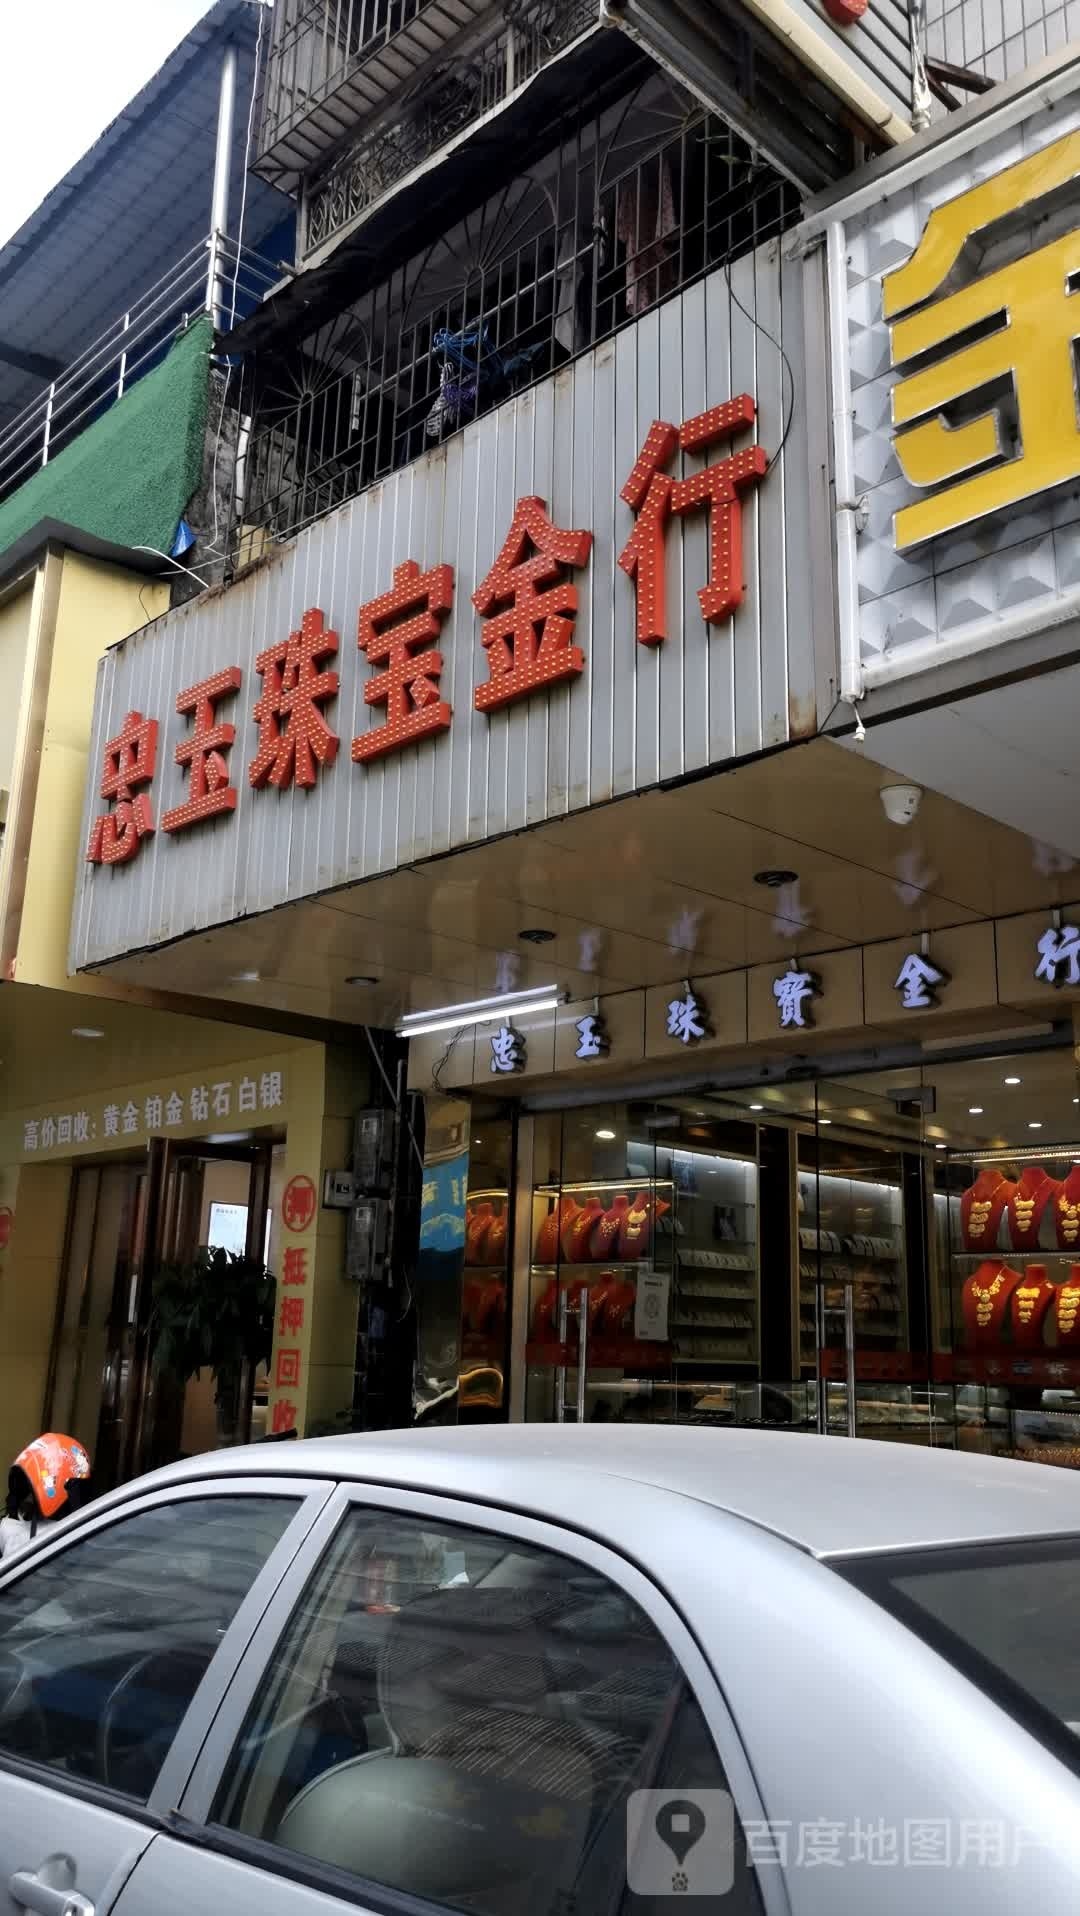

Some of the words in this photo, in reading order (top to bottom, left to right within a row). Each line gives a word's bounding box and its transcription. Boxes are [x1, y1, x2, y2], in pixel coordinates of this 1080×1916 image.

[86, 393, 768, 865] 忠玉珠宝金行
